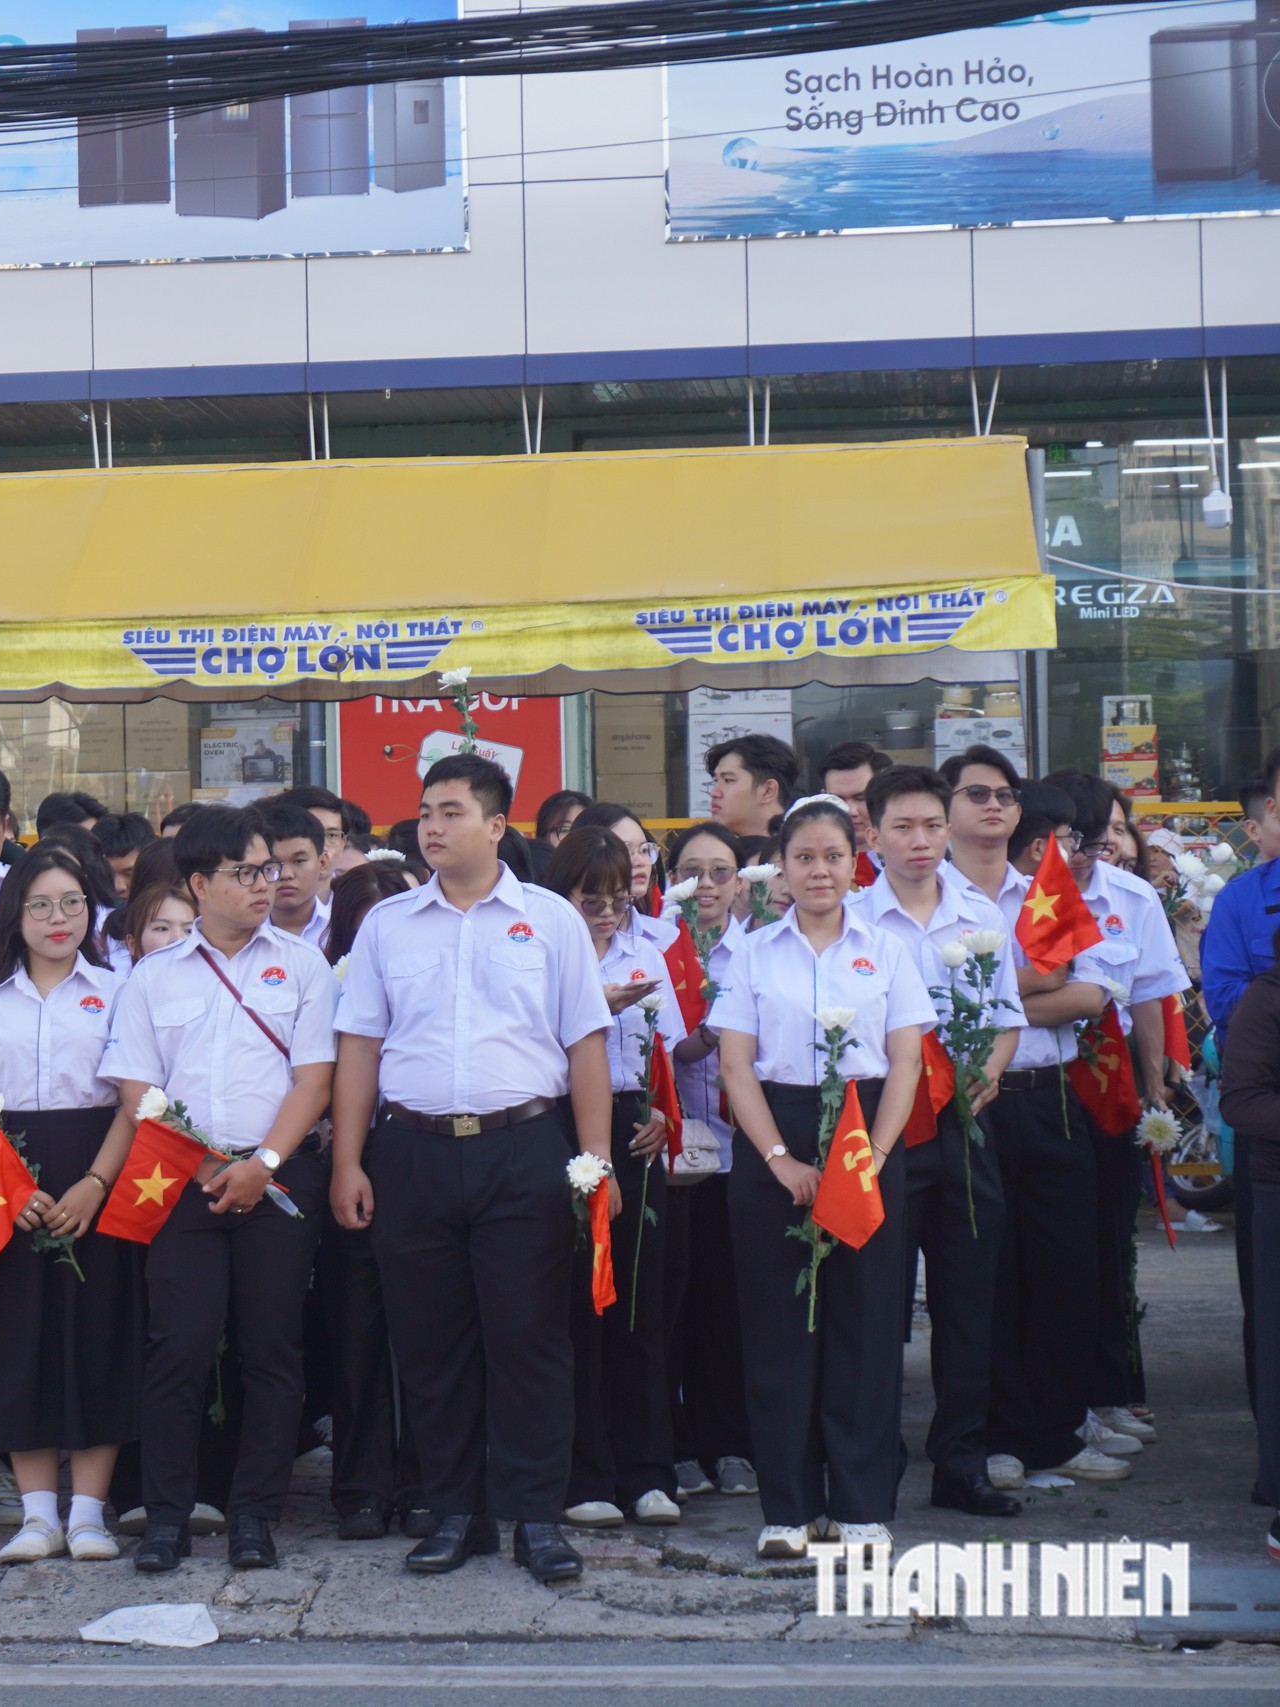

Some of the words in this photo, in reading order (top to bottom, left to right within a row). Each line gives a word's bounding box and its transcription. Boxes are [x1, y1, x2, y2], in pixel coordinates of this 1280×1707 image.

[784, 66, 861, 101] Sạch
[872, 62, 953, 90] Hoàn
[964, 56, 1034, 87] Hảo,
[785, 101, 863, 136] Sống
[874, 98, 946, 127] Đỉnh
[955, 96, 1021, 123] Cao
[635, 608, 685, 625] SIÊU
[693, 605, 731, 624] THỊ
[737, 601, 794, 621] ĐIỆN
[801, 597, 852, 617] MÁY
[877, 592, 921, 613] NỘI
[927, 586, 986, 609] THẤT
[1054, 582, 1176, 606] REGZA
[1079, 607, 1110, 619] Mini
[1113, 606, 1140, 618] LED
[122, 626, 171, 645] SIÊU
[178, 628, 216, 647] THỊ
[222, 625, 277, 644] ĐIỆN
[283, 622, 333, 642] MÁY
[356, 621, 399, 643] NỘI
[406, 616, 463, 637] THẤT
[716, 620, 807, 656] CHỢ
[815, 610, 902, 647] LỚN
[201, 645, 288, 681] CHỢ
[296, 638, 382, 674] LỚN
